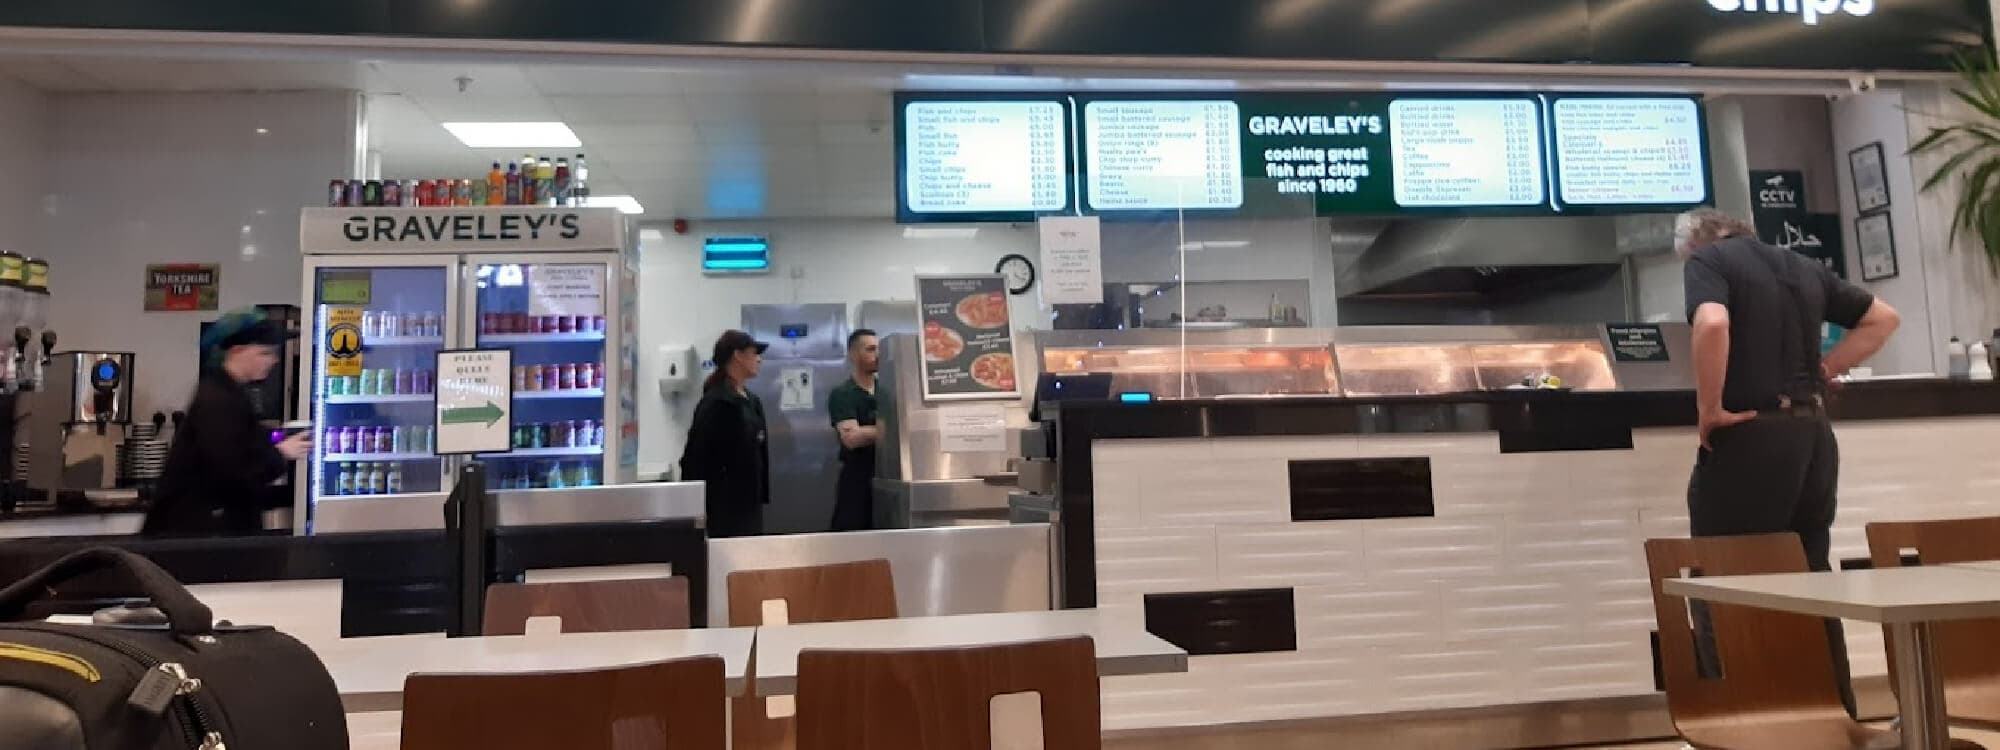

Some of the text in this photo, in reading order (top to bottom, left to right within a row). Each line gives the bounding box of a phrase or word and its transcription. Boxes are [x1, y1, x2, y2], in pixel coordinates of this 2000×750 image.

[1249, 116, 1382, 135] GRAVELEY'S
[1264, 147, 1369, 163] cooking great
[1265, 163, 1370, 178] fish and chips
[1278, 178, 1358, 193] since 1960
[1759, 190, 1795, 201] CCTV
[343, 213, 579, 241] GRAVELEY'S
[1776, 220, 1822, 249] حلال
[153, 272, 210, 285] YORKSHIRE
[173, 285, 192, 295] TEA
